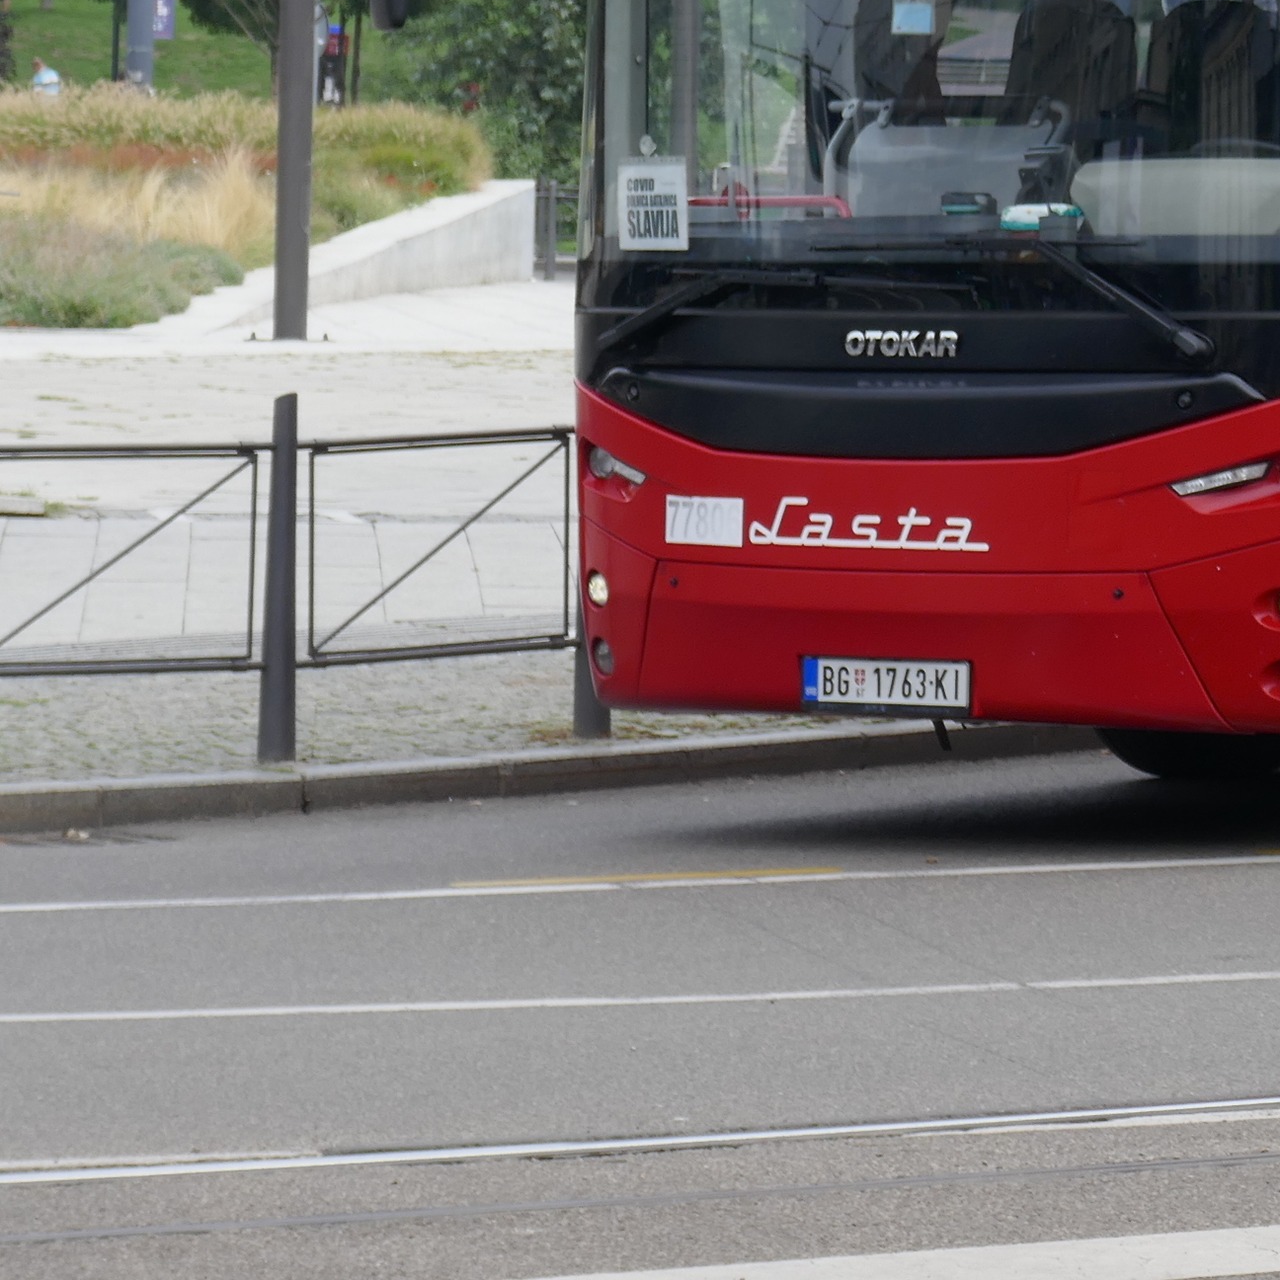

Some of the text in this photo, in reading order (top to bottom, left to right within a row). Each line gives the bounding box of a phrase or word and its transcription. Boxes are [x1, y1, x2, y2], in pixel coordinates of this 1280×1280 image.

[627, 178, 655, 191] COVID
[627, 209, 679, 239] SLAVIJA
[845, 330, 958, 357] OTOKAR
[750, 496, 990, 552] Lasta
[823, 666, 850, 696] BG
